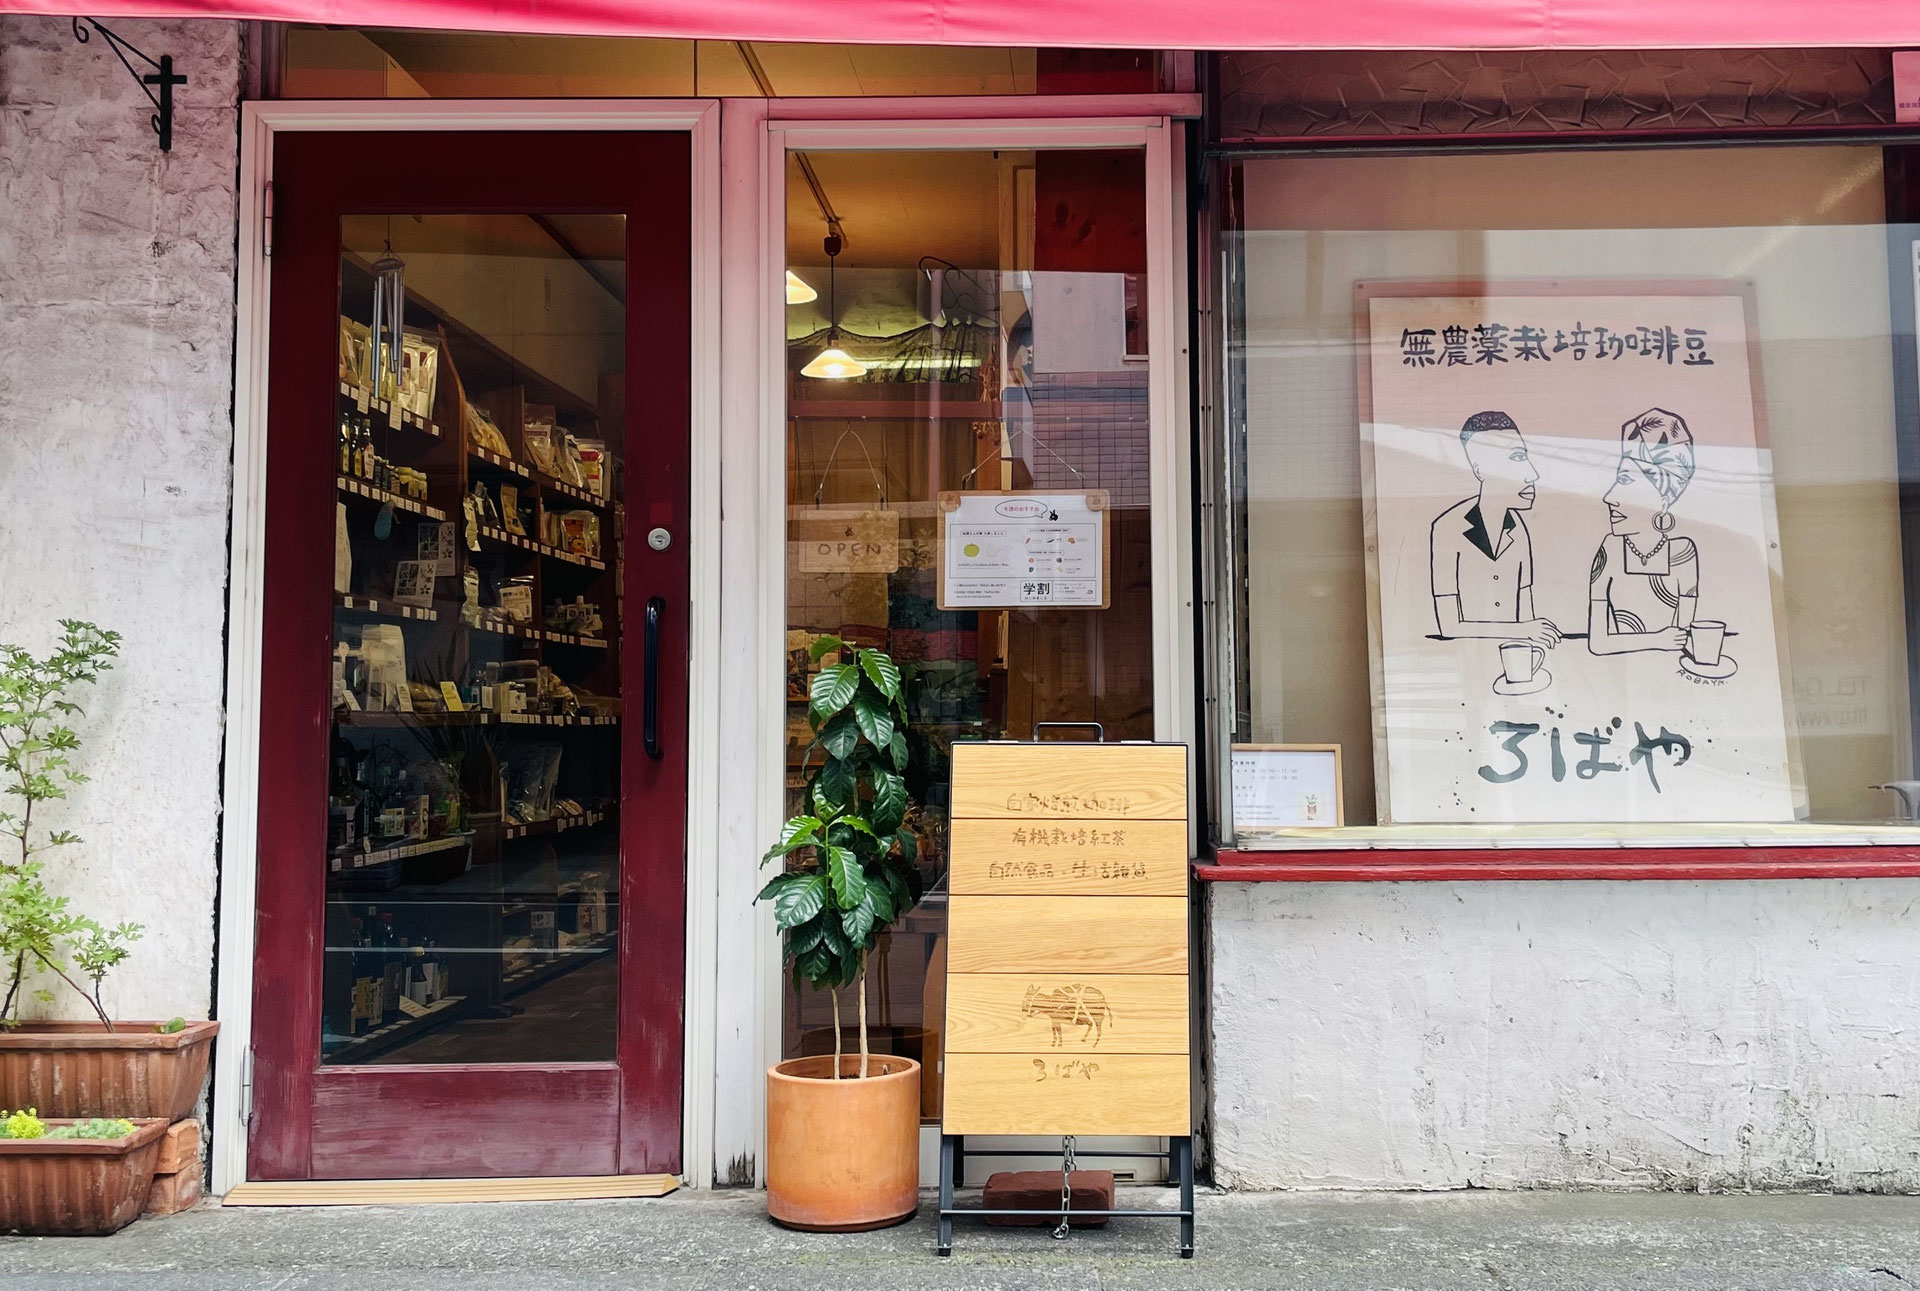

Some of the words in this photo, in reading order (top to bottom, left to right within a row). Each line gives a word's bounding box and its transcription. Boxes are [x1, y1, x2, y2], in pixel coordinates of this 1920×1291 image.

[1400, 321, 1714, 368] 無農薬栽培珈琲豆
[818, 542, 882, 557] OPEN
[1023, 582, 1050, 596] 学割
[1478, 716, 1691, 794] ろばや
[1012, 827, 1126, 847] 有機栽培紅茶
